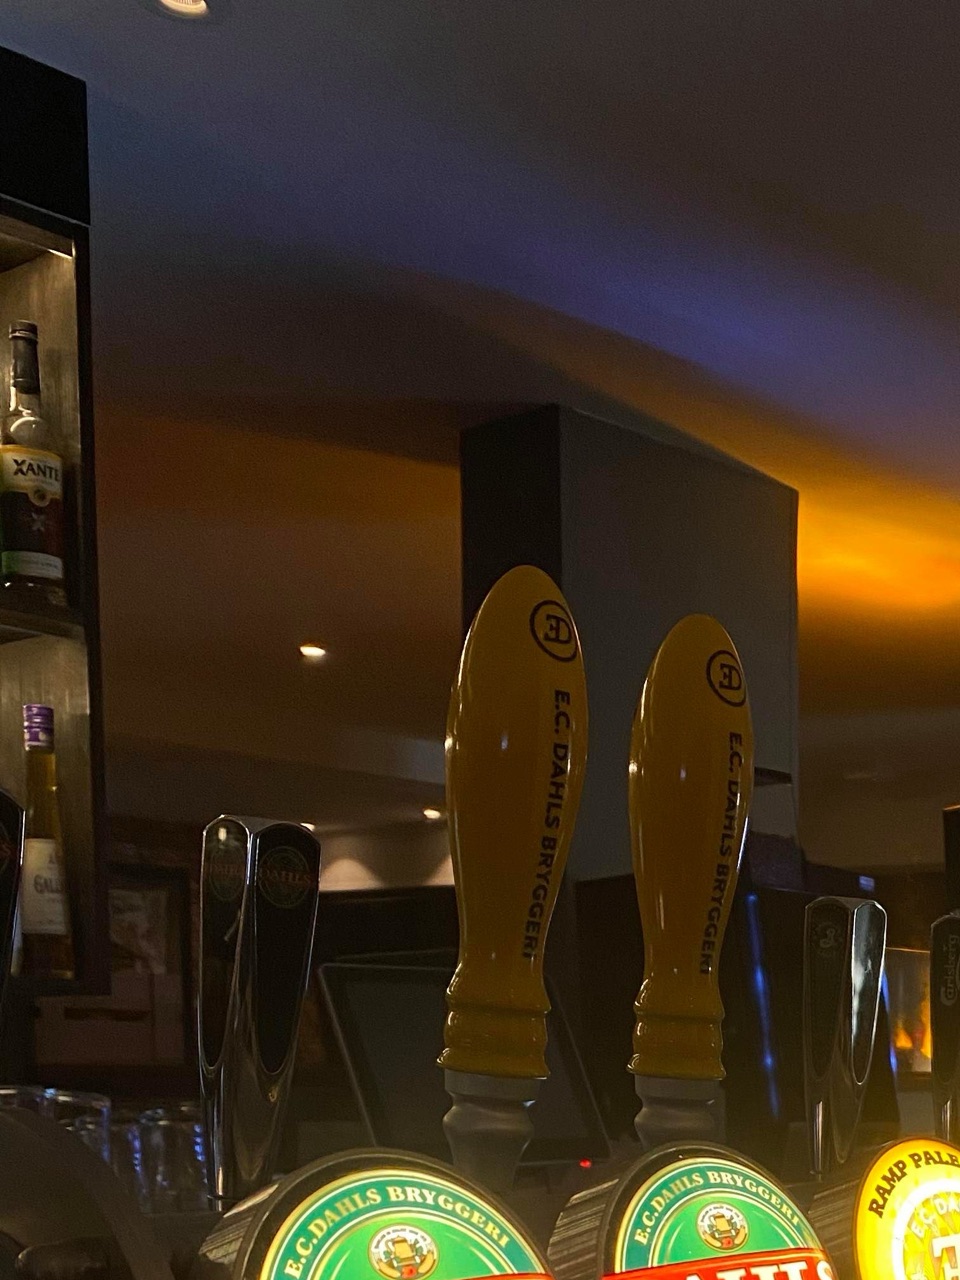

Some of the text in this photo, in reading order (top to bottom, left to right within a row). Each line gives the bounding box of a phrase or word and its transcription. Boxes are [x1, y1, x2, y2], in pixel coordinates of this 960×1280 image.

[522, 689, 571, 960] E.C. DAHLS BRYGGERI
[699, 731, 743, 976] E.C. DAHLS BRYGGERI
[940, 934, 960, 1006] Carlsberg
[385, 1185, 512, 1249] BRYGGERI
[706, 1170, 801, 1226] BRYGGERI
[868, 1159, 908, 1219] RAMP
